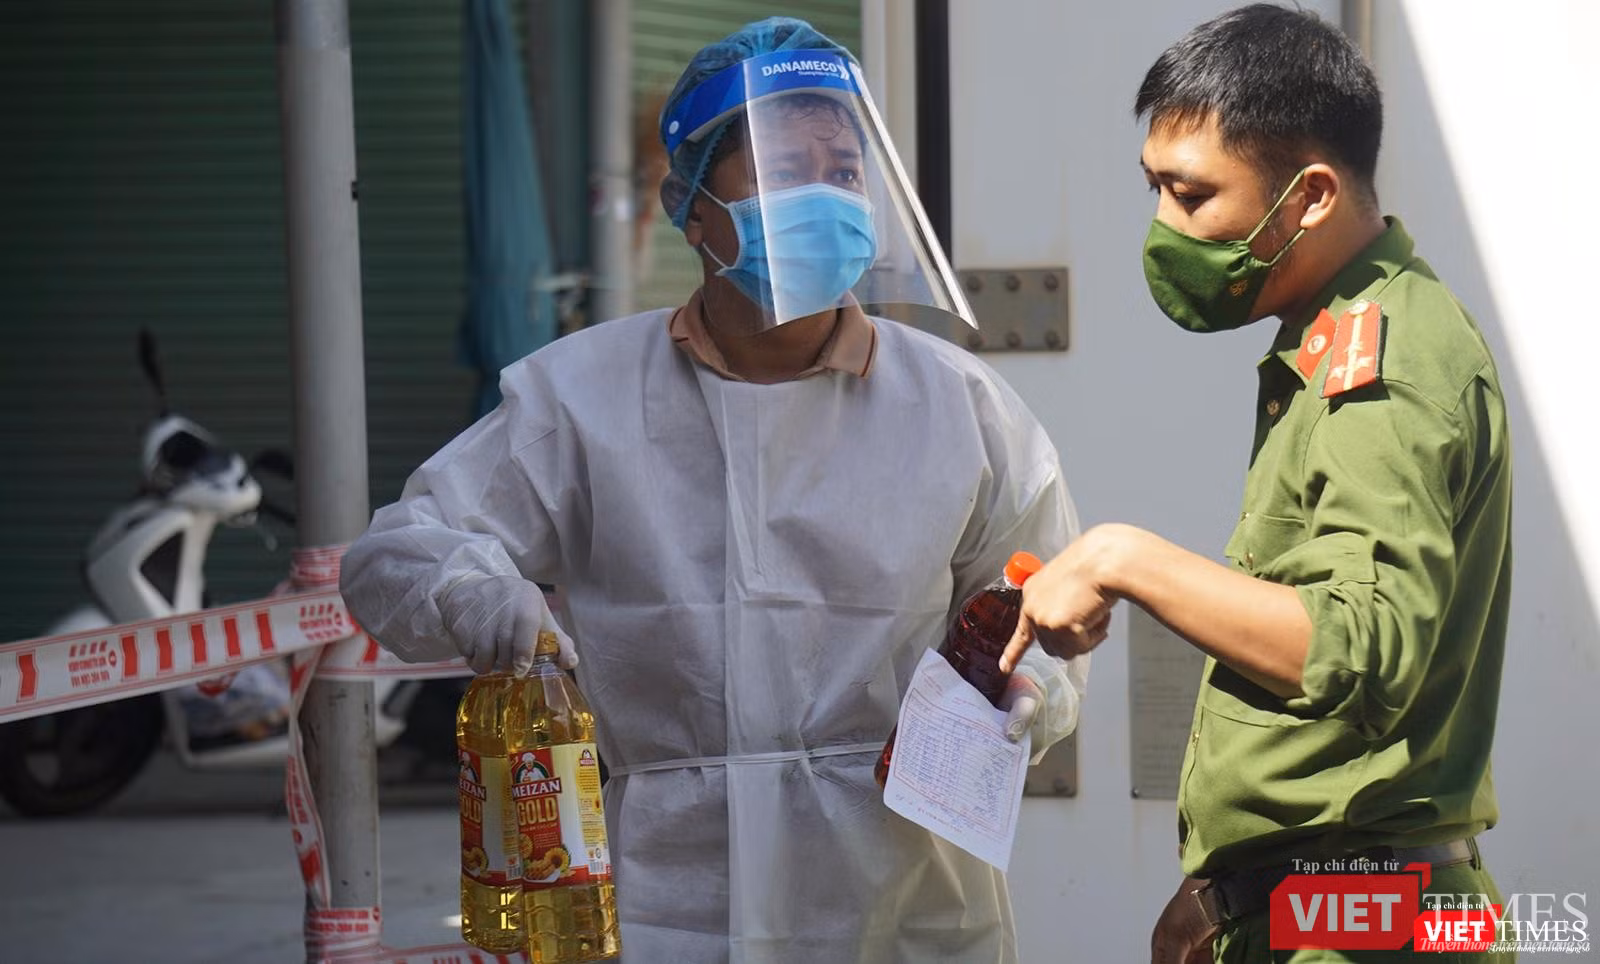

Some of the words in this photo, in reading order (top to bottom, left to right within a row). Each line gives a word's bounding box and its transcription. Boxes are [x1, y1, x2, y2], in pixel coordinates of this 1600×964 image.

[761, 61, 837, 77] DANAMECO
[460, 780, 485, 799] EIZAN
[512, 780, 561, 797] MEIZAN
[460, 795, 481, 823] OLD
[516, 797, 558, 826] GOLD
